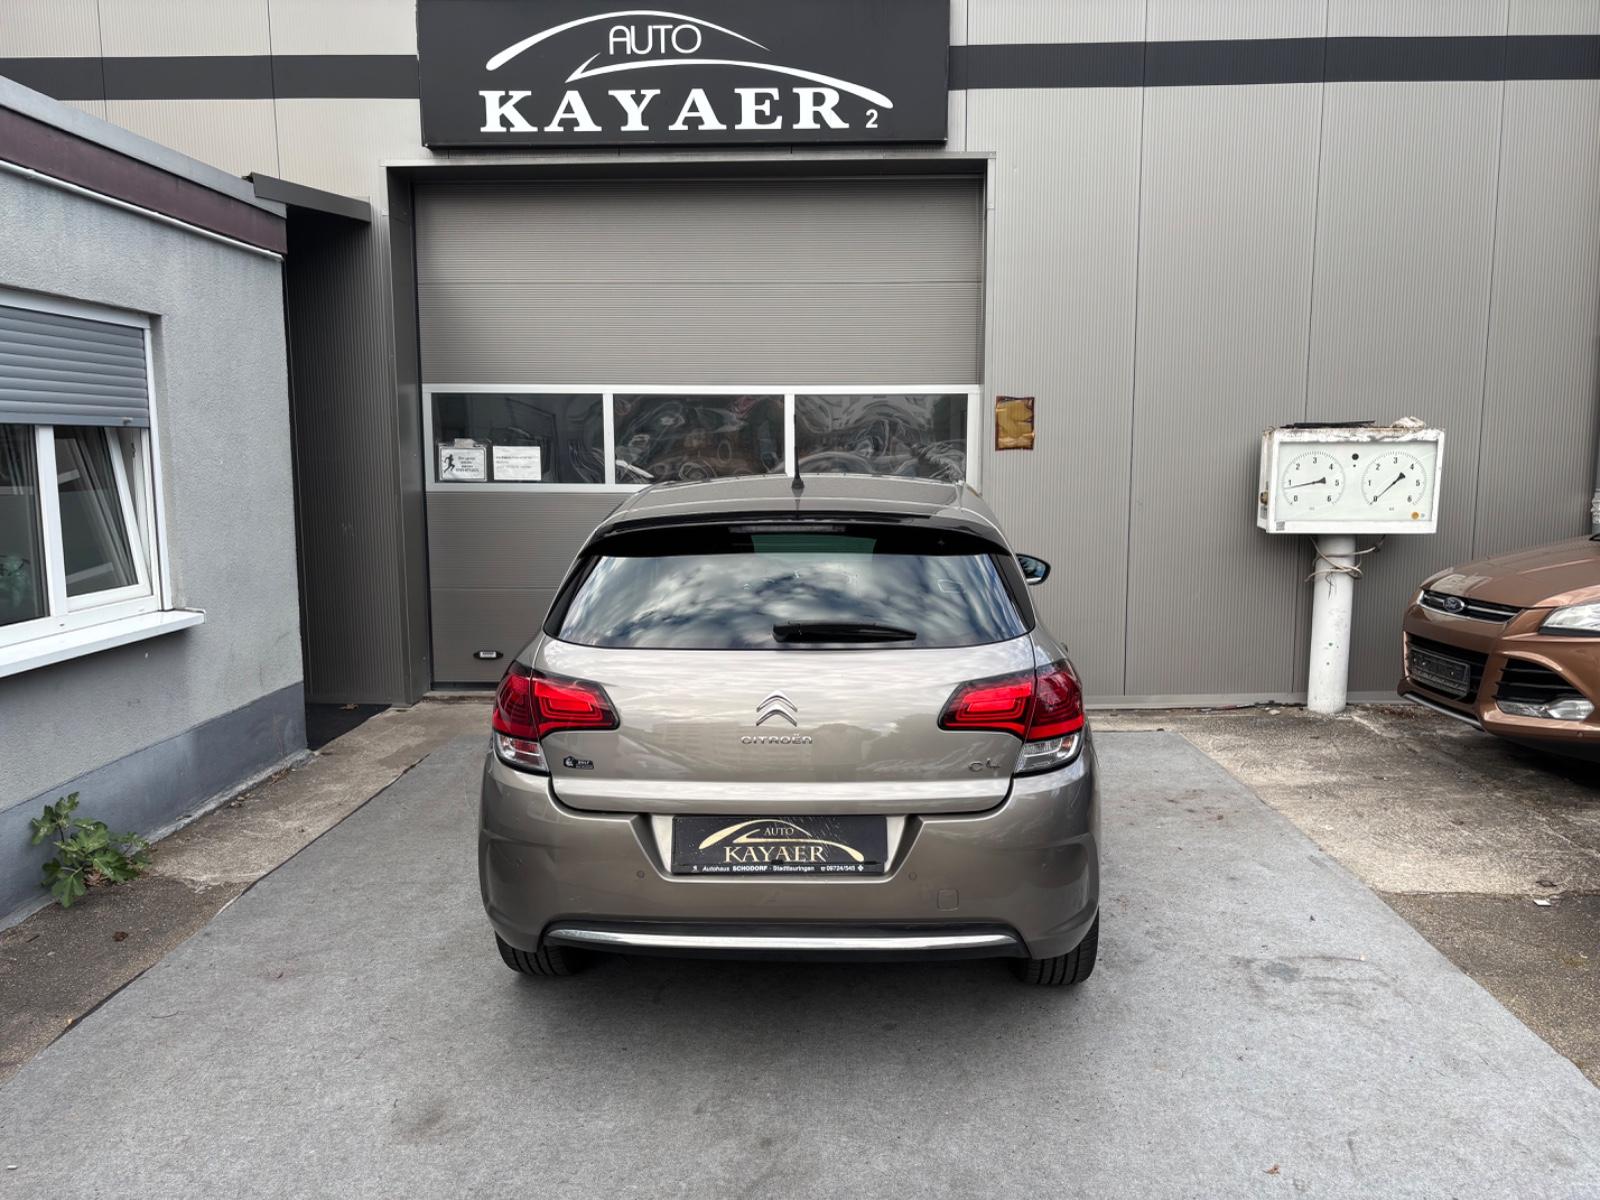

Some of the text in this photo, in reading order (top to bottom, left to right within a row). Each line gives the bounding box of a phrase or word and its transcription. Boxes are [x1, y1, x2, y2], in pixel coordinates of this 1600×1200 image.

[608, 24, 701, 55] AUTO
[479, 87, 879, 133] KAYAER 2
[740, 733, 813, 745] CITROËN
[764, 827, 794, 836] AUTO
[723, 846, 827, 863] KAYAER
